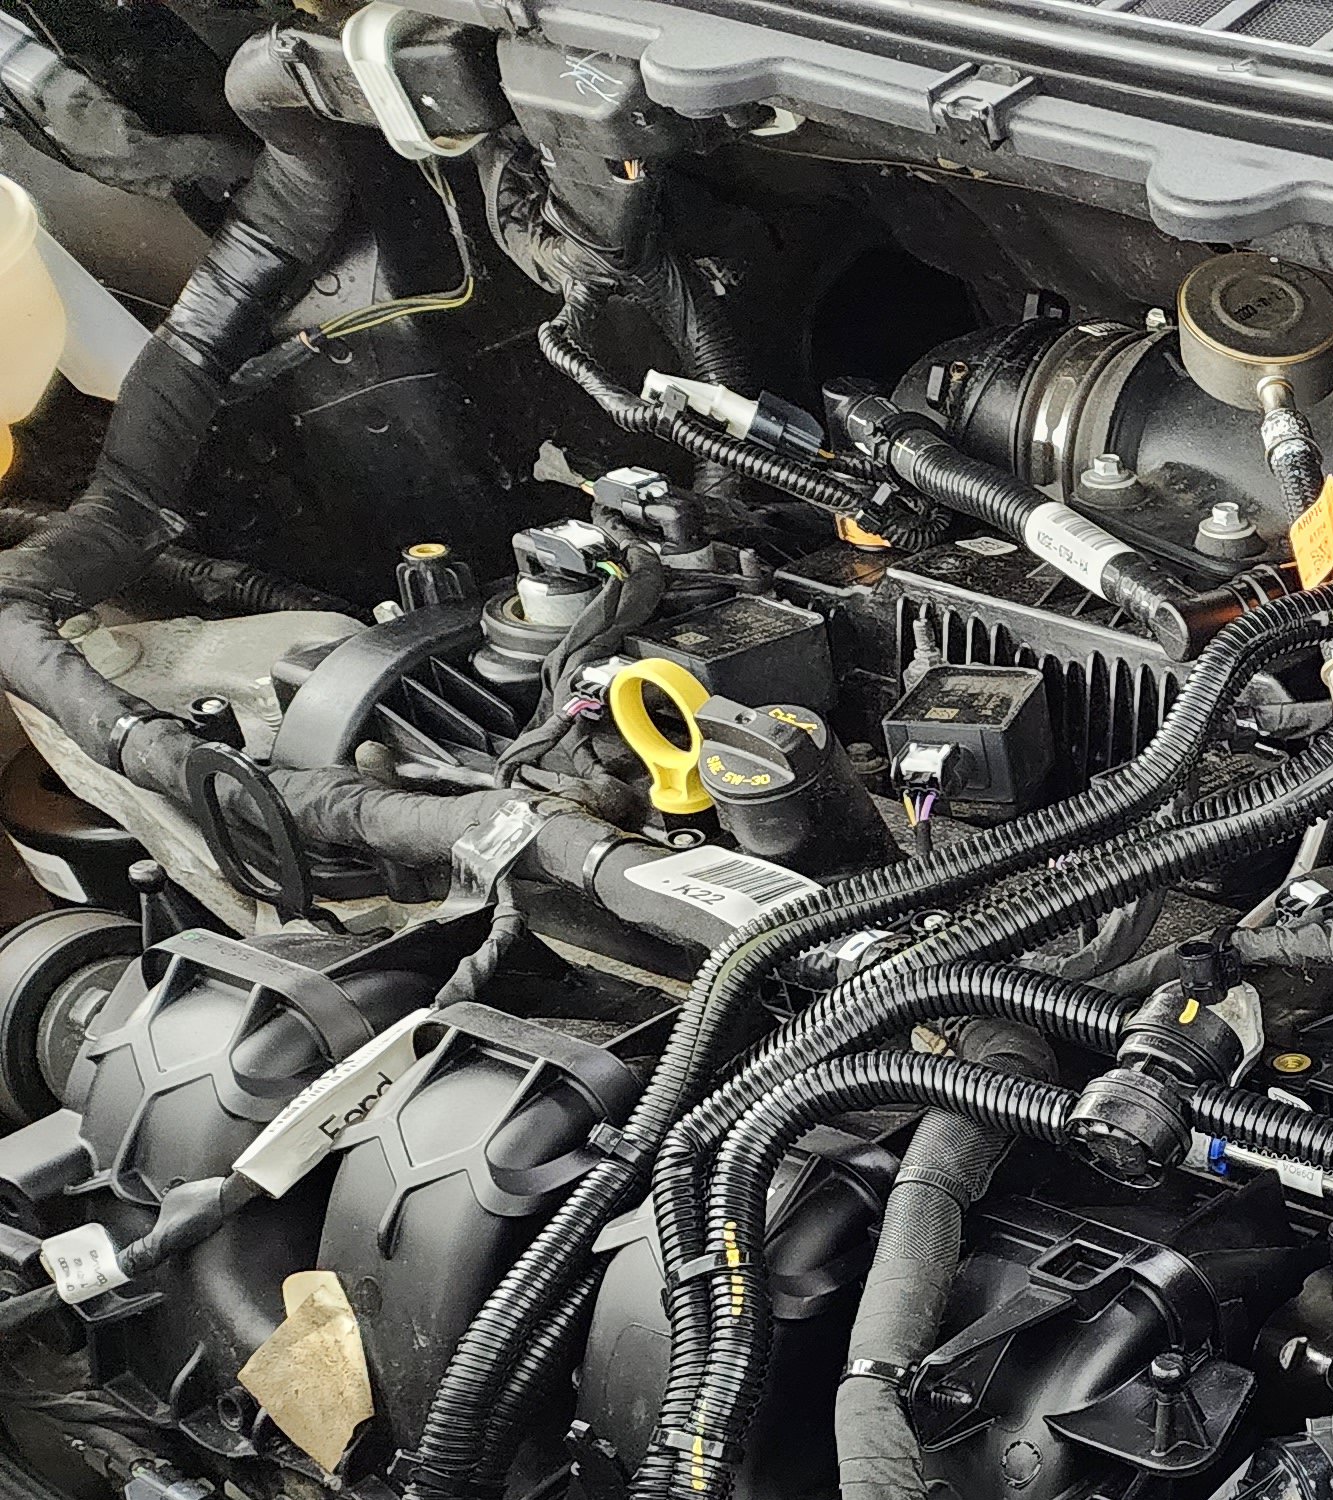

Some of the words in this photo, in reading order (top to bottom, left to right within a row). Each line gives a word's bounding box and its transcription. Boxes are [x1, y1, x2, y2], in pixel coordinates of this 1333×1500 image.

[706, 755, 726, 775] SAE
[721, 771, 770, 785] 5W-30
[672, 882, 725, 907] K22
